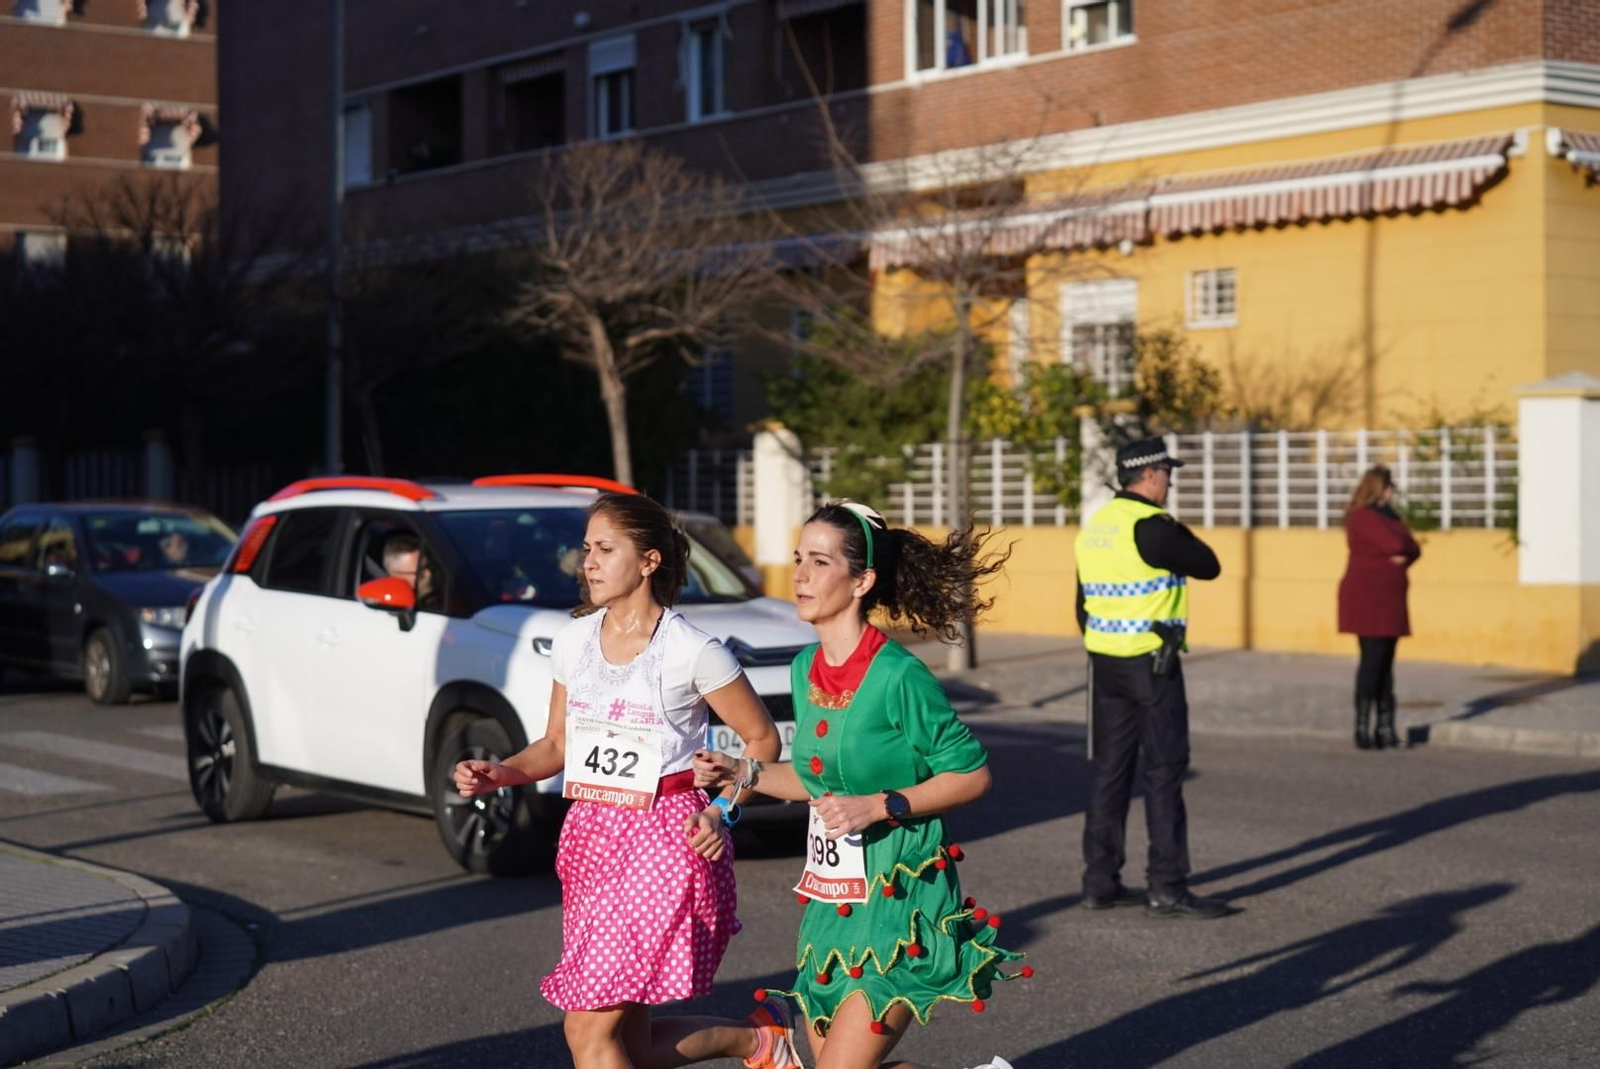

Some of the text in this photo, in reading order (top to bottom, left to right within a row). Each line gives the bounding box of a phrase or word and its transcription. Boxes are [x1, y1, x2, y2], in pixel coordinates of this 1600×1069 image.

[584, 745, 640, 779] 432
[571, 783, 634, 806] Cruzcampo
[810, 833, 840, 867] 398
